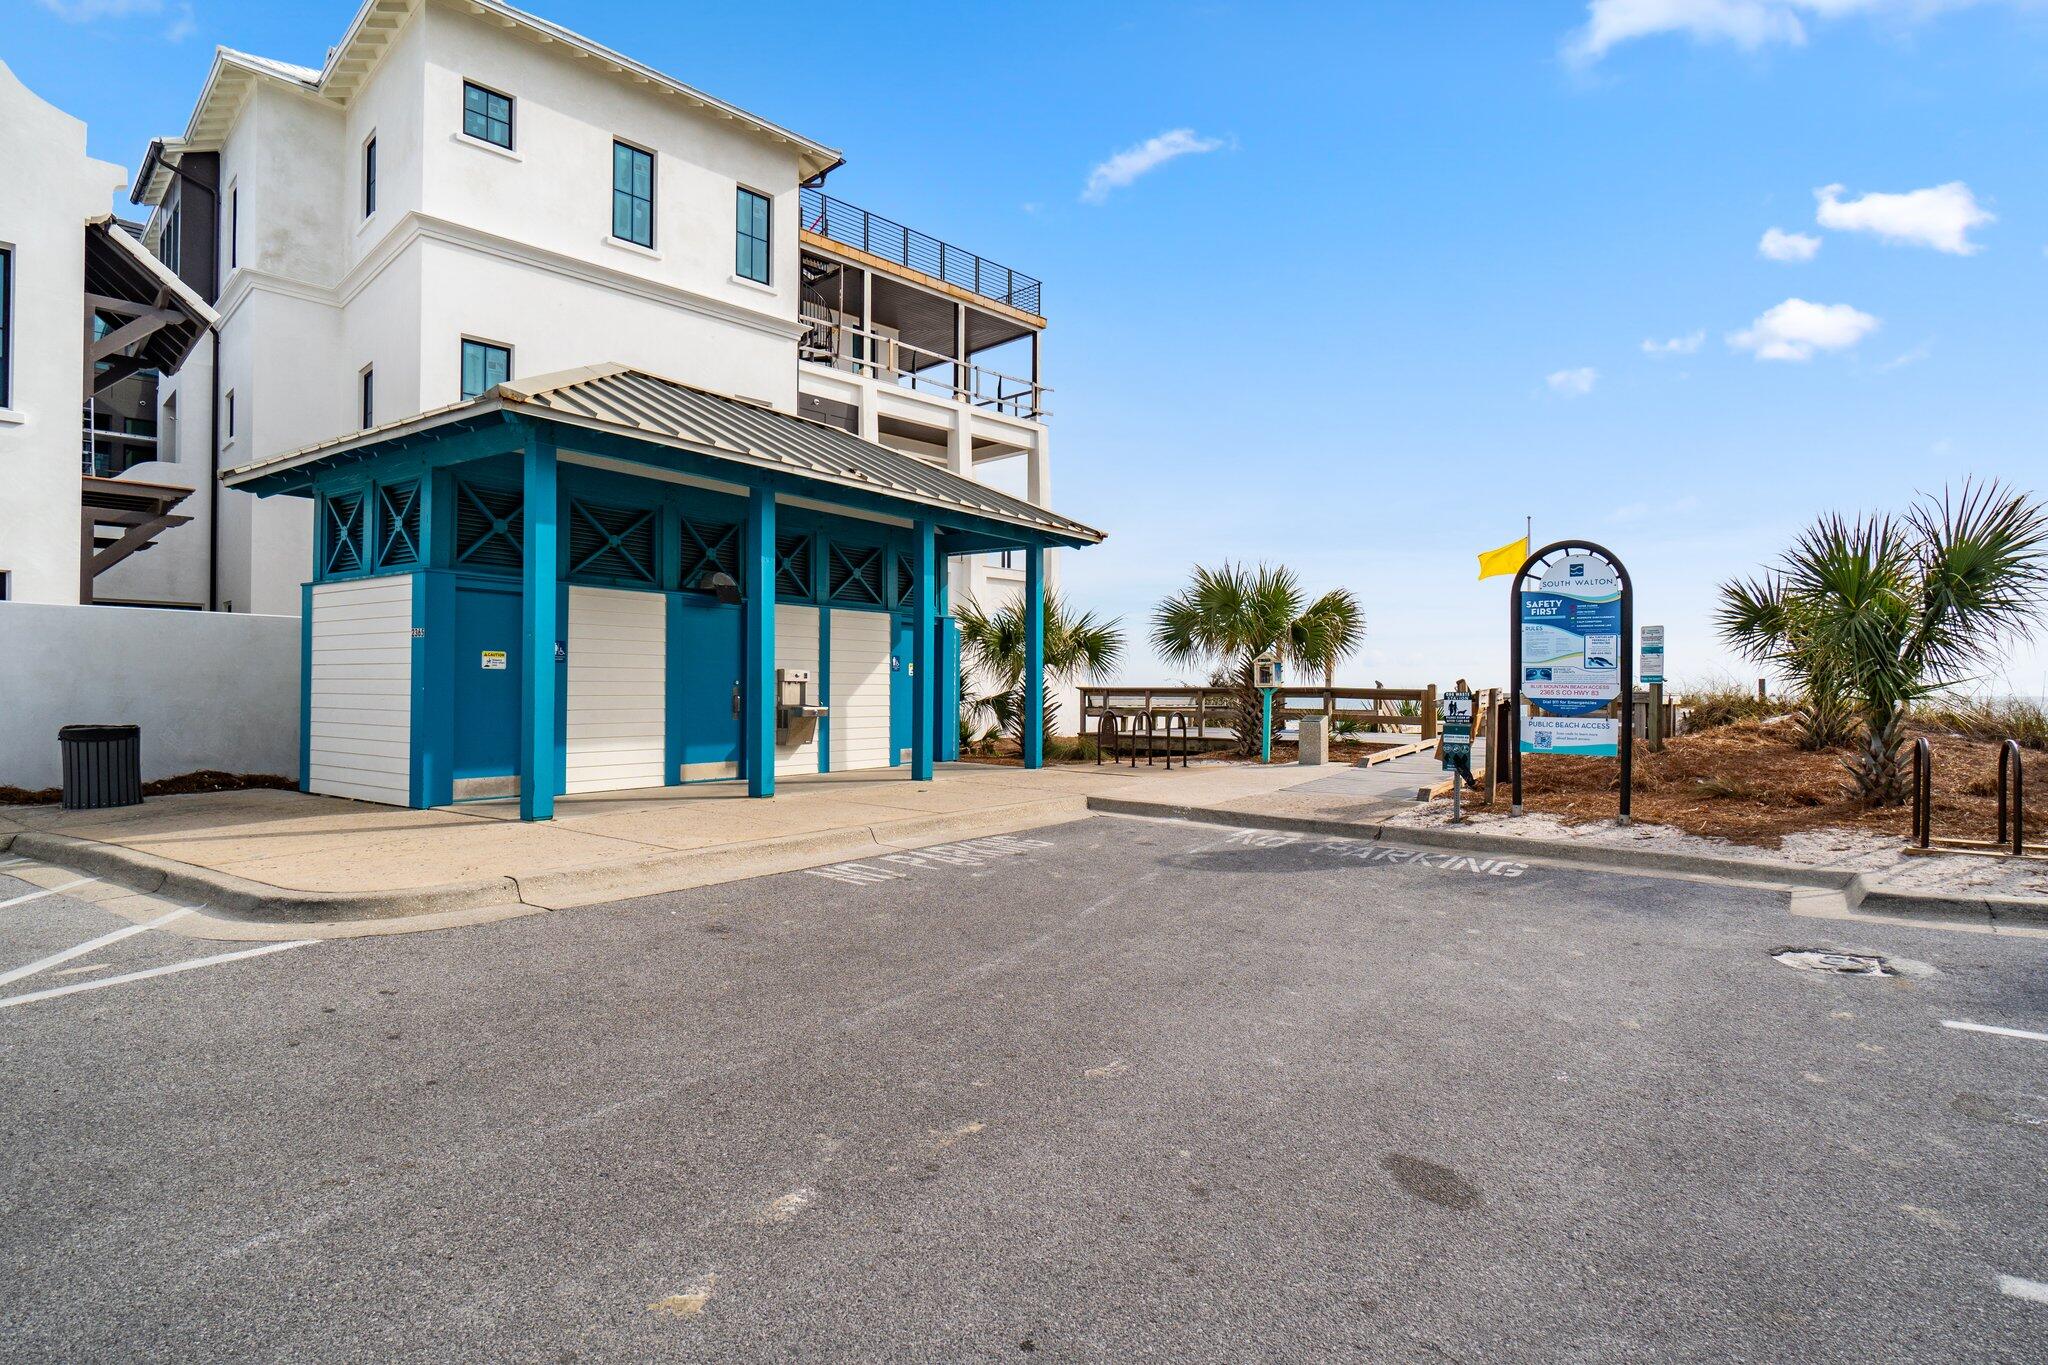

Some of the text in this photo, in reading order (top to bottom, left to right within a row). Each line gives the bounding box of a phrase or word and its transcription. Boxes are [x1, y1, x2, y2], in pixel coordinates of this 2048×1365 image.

[1542, 578, 1613, 588] SOUTH WALTON
[1526, 600, 1563, 608] SAFETY
[1531, 607, 1557, 615] FIRST
[879, 835, 1054, 870] PARKING
[1225, 828, 1528, 877] NO PARKING
